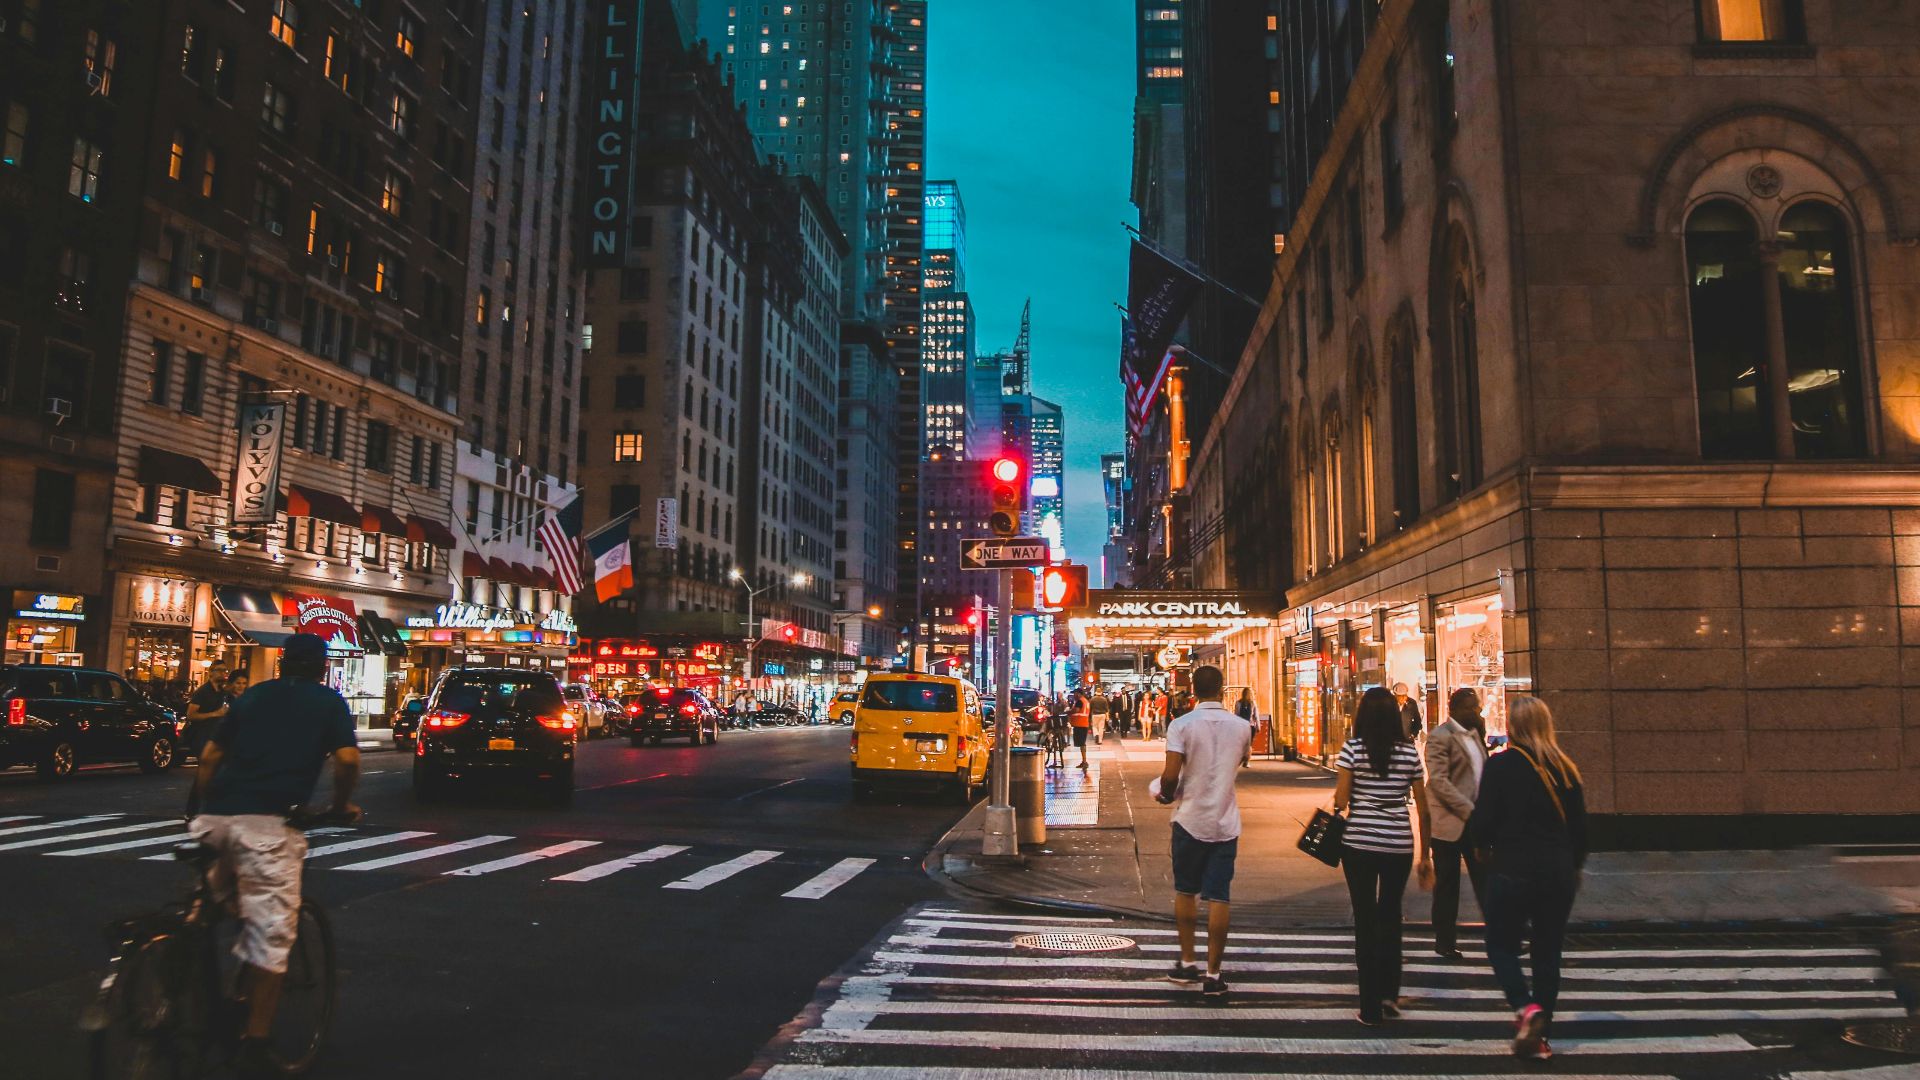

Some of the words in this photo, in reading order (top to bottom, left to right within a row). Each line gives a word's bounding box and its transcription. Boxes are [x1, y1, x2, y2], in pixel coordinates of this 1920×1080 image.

[244, 408, 275, 509] MOLYVOS
[976, 548, 999, 559] ONE
[1012, 547, 1038, 559] WAY
[1100, 602, 1151, 615] PARK
[1151, 602, 1246, 615] CENTRAL
[133, 611, 191, 623] MOLYVOS
[407, 617, 434, 627] HOTEL
[437, 604, 515, 633] Wellington
[595, 663, 627, 674] BEN
